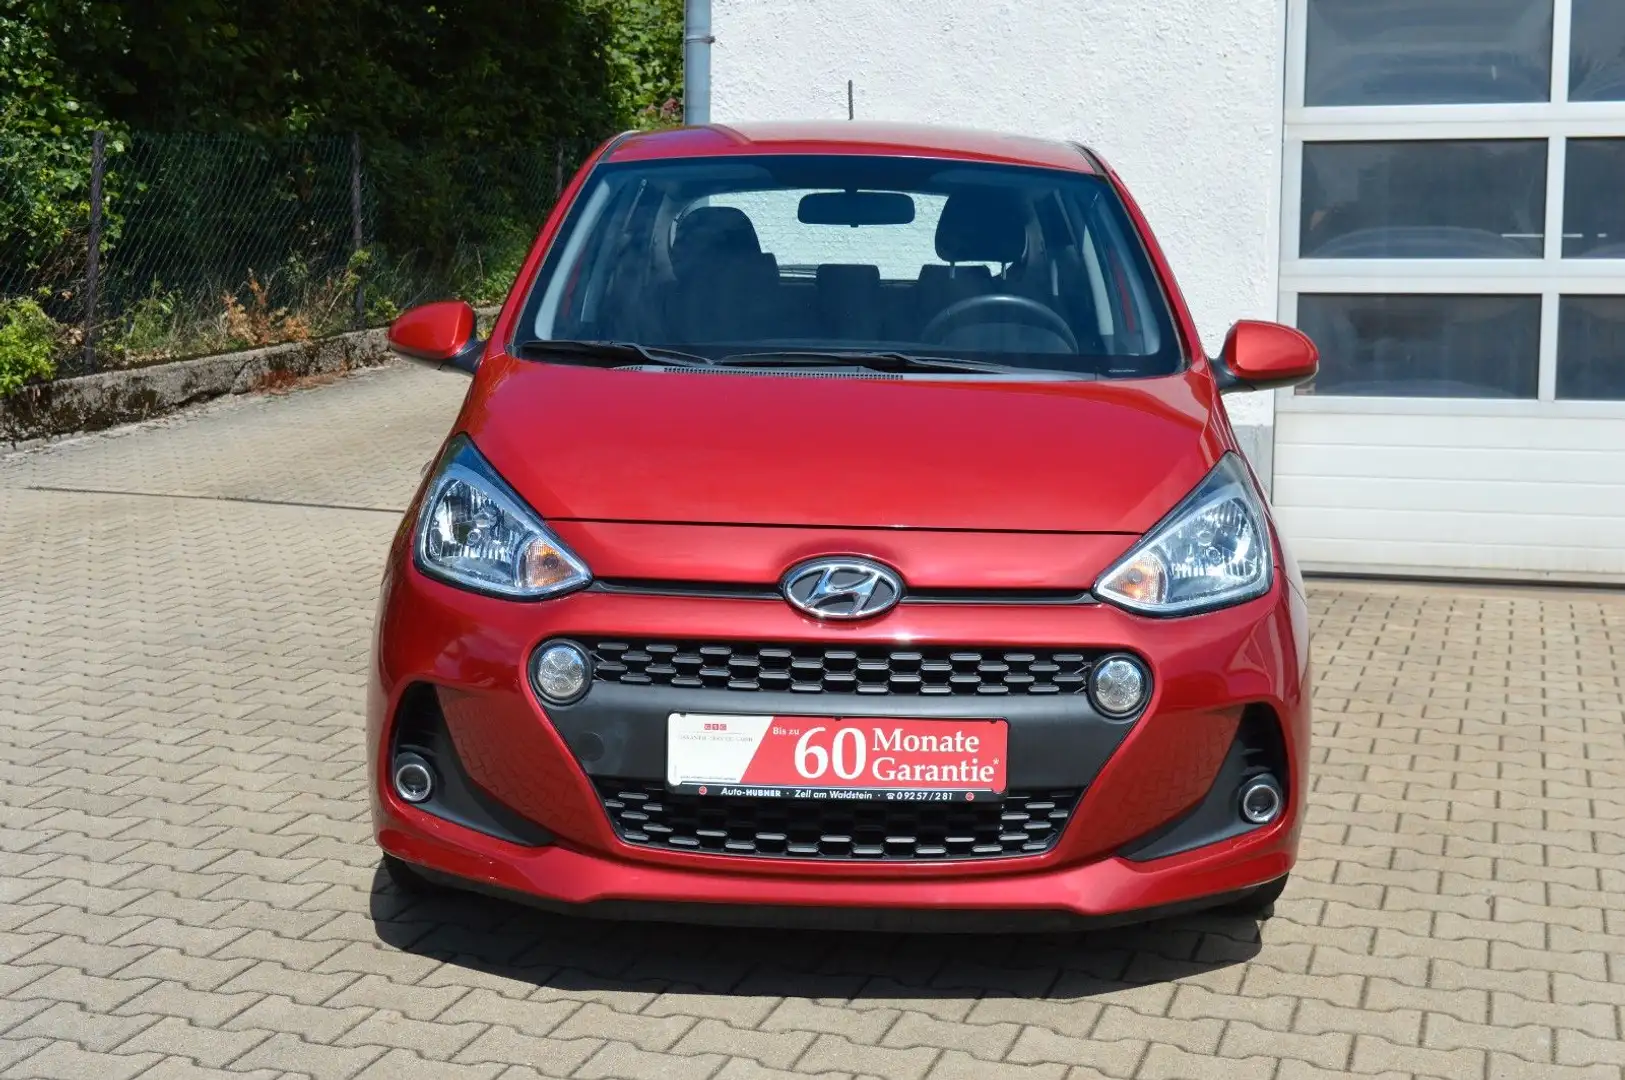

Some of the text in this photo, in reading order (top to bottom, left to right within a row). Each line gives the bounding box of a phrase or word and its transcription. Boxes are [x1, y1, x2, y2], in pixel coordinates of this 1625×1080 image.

[772, 727, 800, 736] Bis zu
[872, 727, 980, 754] Monate
[794, 726, 867, 780] 60
[794, 789, 812, 798] Zell
[813, 790, 827, 799] am
[829, 790, 873, 800] Waldstein
